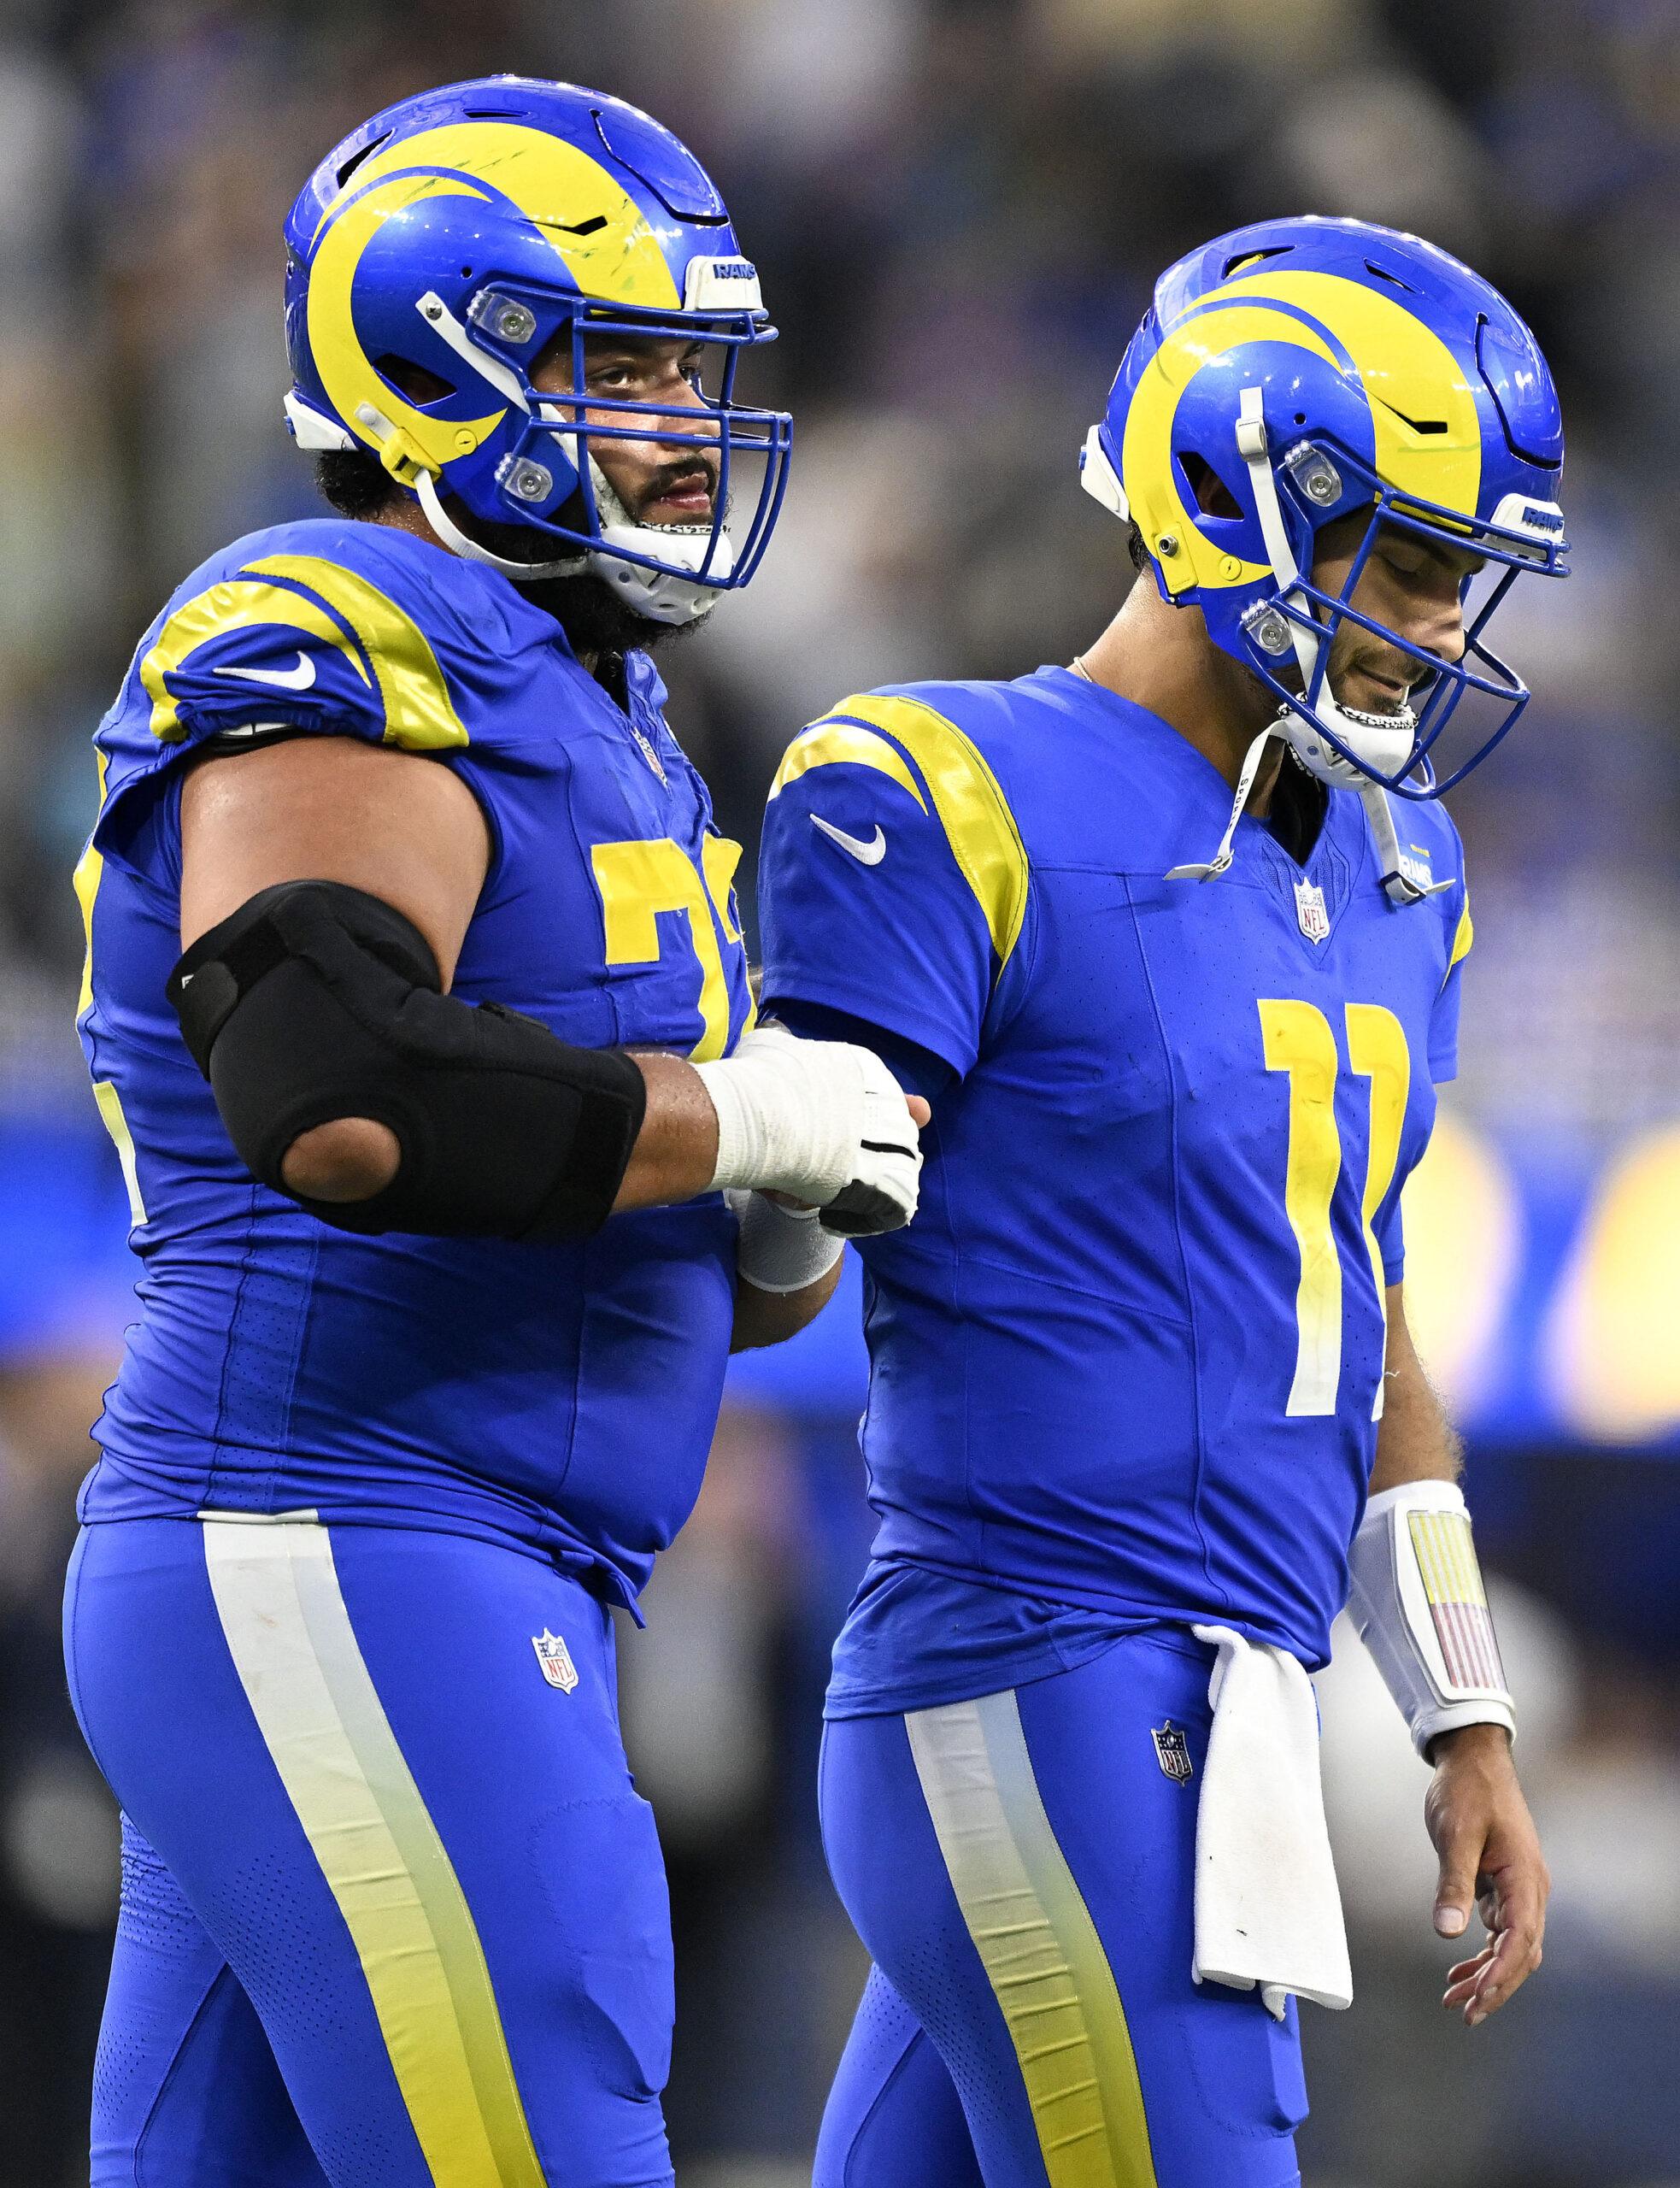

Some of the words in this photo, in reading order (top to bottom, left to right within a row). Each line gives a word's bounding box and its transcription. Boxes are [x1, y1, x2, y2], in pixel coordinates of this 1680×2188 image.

[713, 263, 755, 279] RAMS
[1522, 506, 1565, 531] RAMS
[1302, 908, 1325, 932] NFL
[1257, 998, 1411, 1422] 11
[546, 1658, 573, 1681] NFL
[1162, 1750, 1190, 1775] NFL
